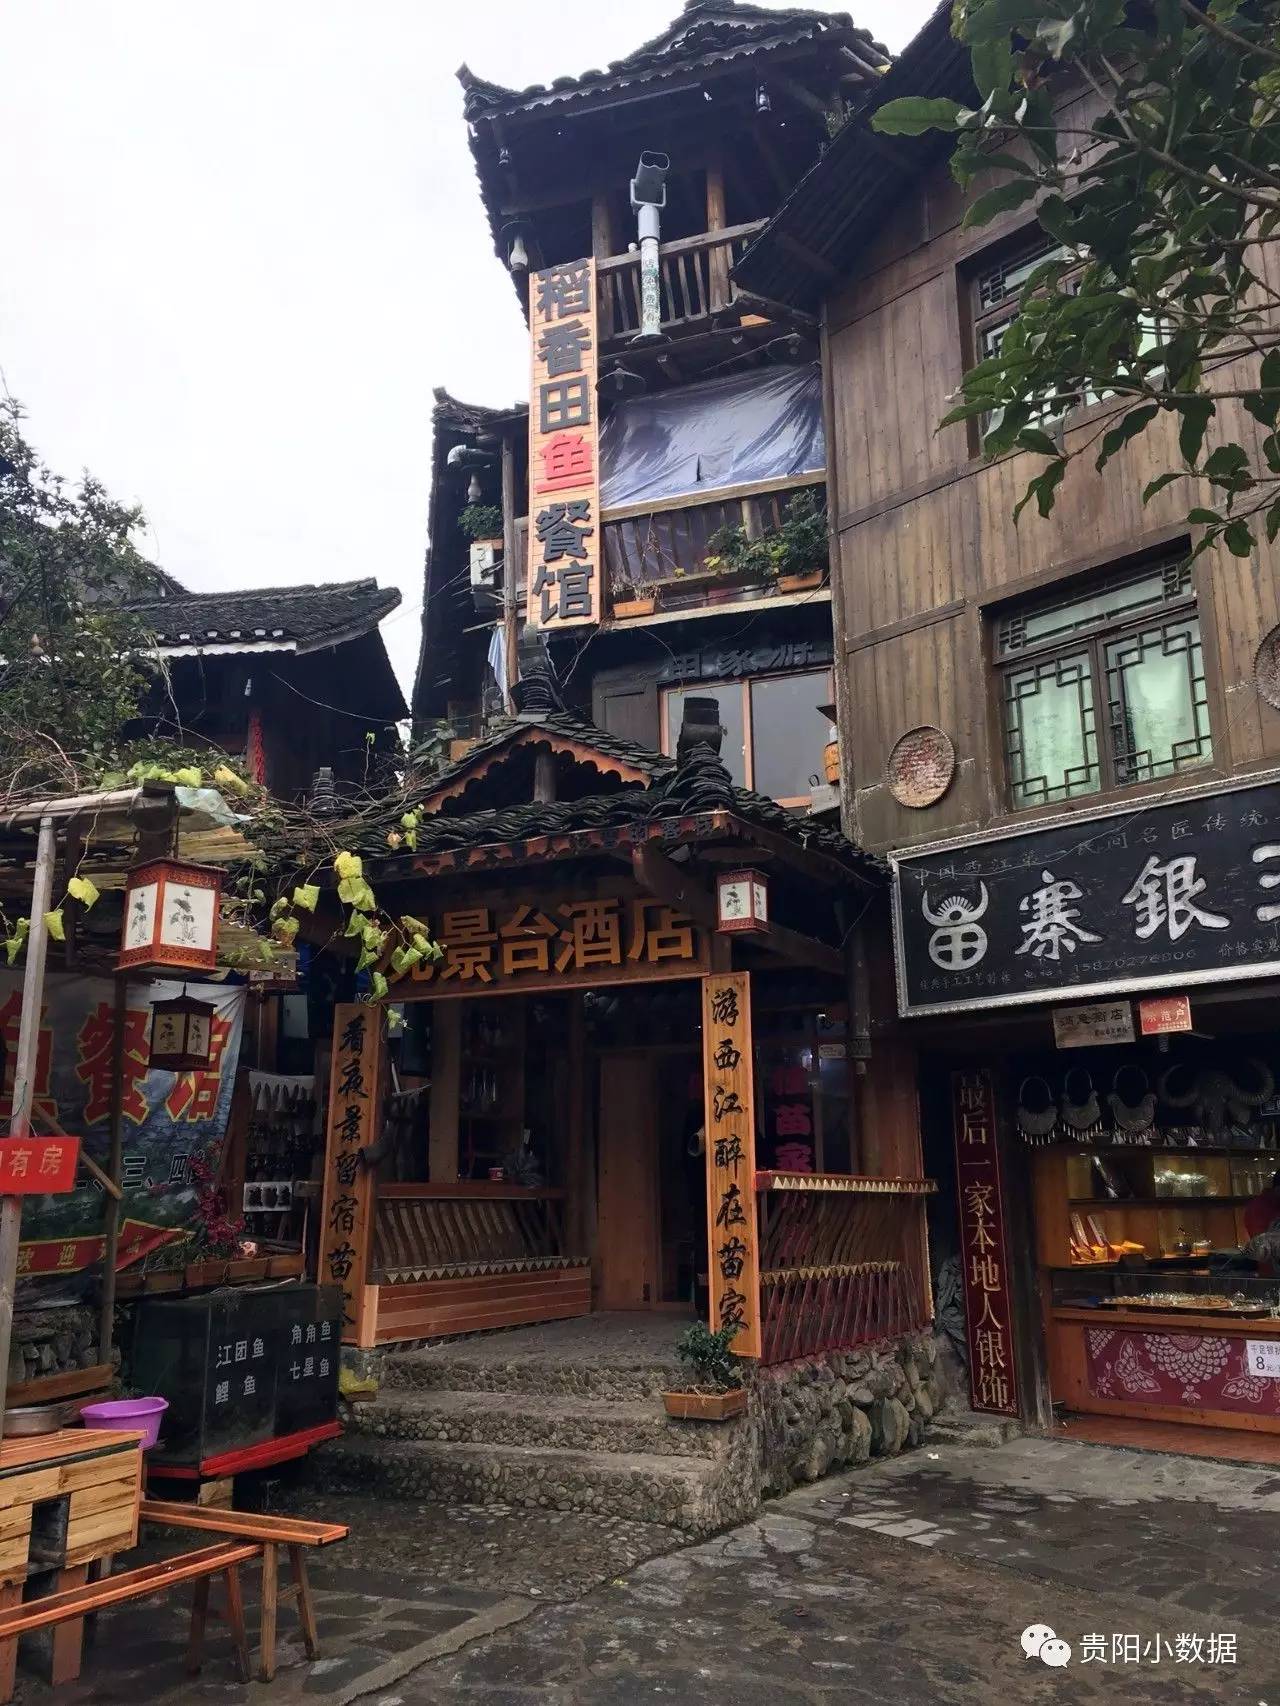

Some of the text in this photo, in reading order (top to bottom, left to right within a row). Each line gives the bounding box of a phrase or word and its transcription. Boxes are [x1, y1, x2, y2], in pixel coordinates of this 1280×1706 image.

[532, 258, 594, 625] 稻香田鱼餐馆
[0, 1145, 63, 1177] 有房
[710, 988, 750, 1331] 游西江醉在苗家
[958, 1076, 1010, 1409] 最后一家本地人银饰
[290, 1320, 332, 1346] 角角鱼
[215, 1337, 265, 1369] 江团鱼
[289, 1356, 330, 1381] 七星鱼
